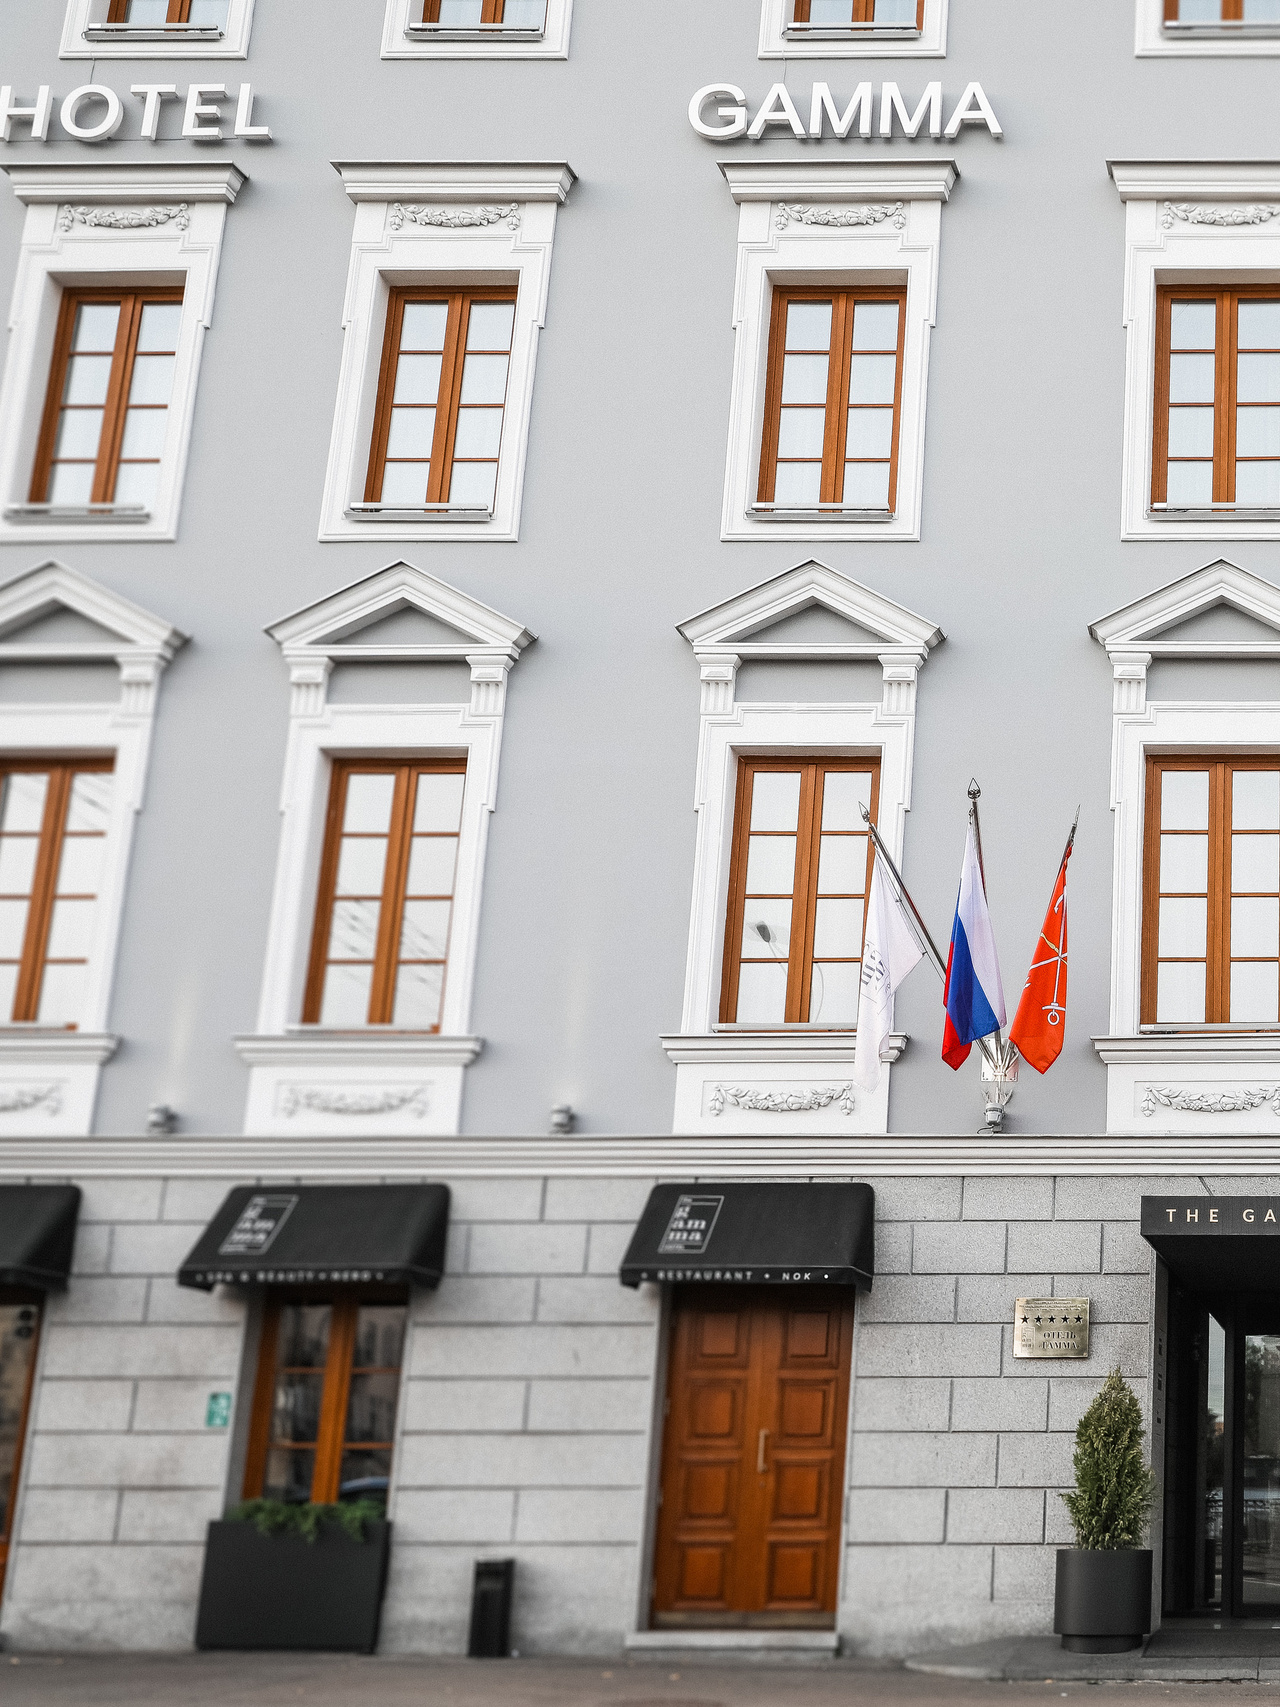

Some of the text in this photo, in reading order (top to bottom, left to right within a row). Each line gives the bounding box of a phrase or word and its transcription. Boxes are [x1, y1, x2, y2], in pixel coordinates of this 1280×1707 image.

[0, 83, 272, 141] HOTEL
[687, 81, 1003, 140] GAMMA
[1166, 1208, 1219, 1222] THE
[657, 1269, 812, 1281] RESTAURANT NOK
